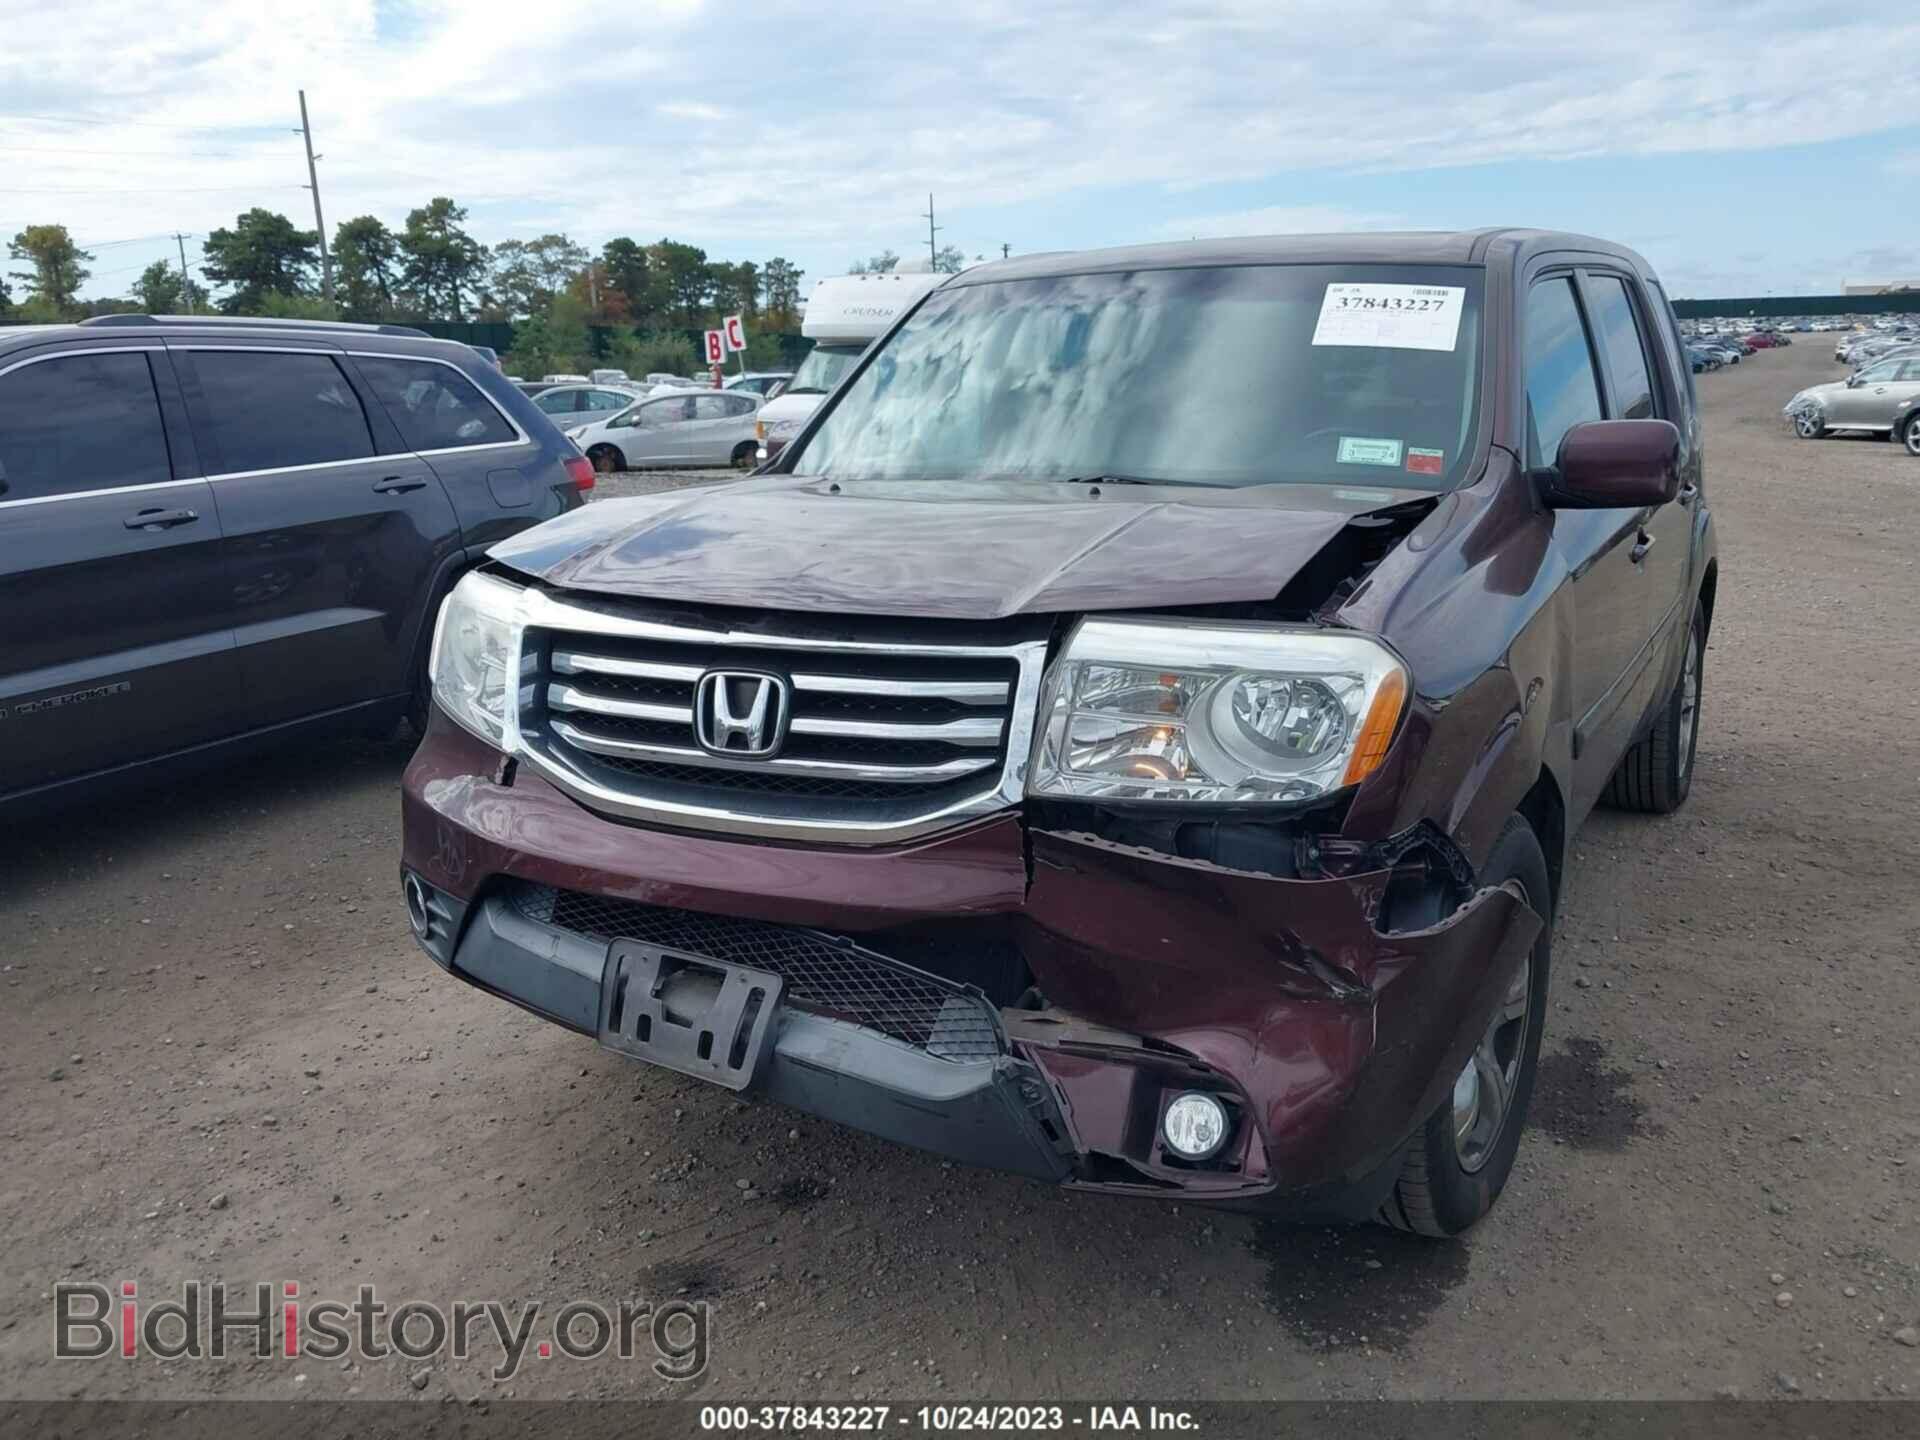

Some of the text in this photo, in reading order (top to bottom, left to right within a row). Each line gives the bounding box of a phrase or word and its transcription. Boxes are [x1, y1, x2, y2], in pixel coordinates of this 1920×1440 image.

[1336, 297, 1444, 312] 37843227
[708, 332, 721, 360] B
[728, 319, 742, 348] C
[14, 680, 131, 713] CHEROKEE
